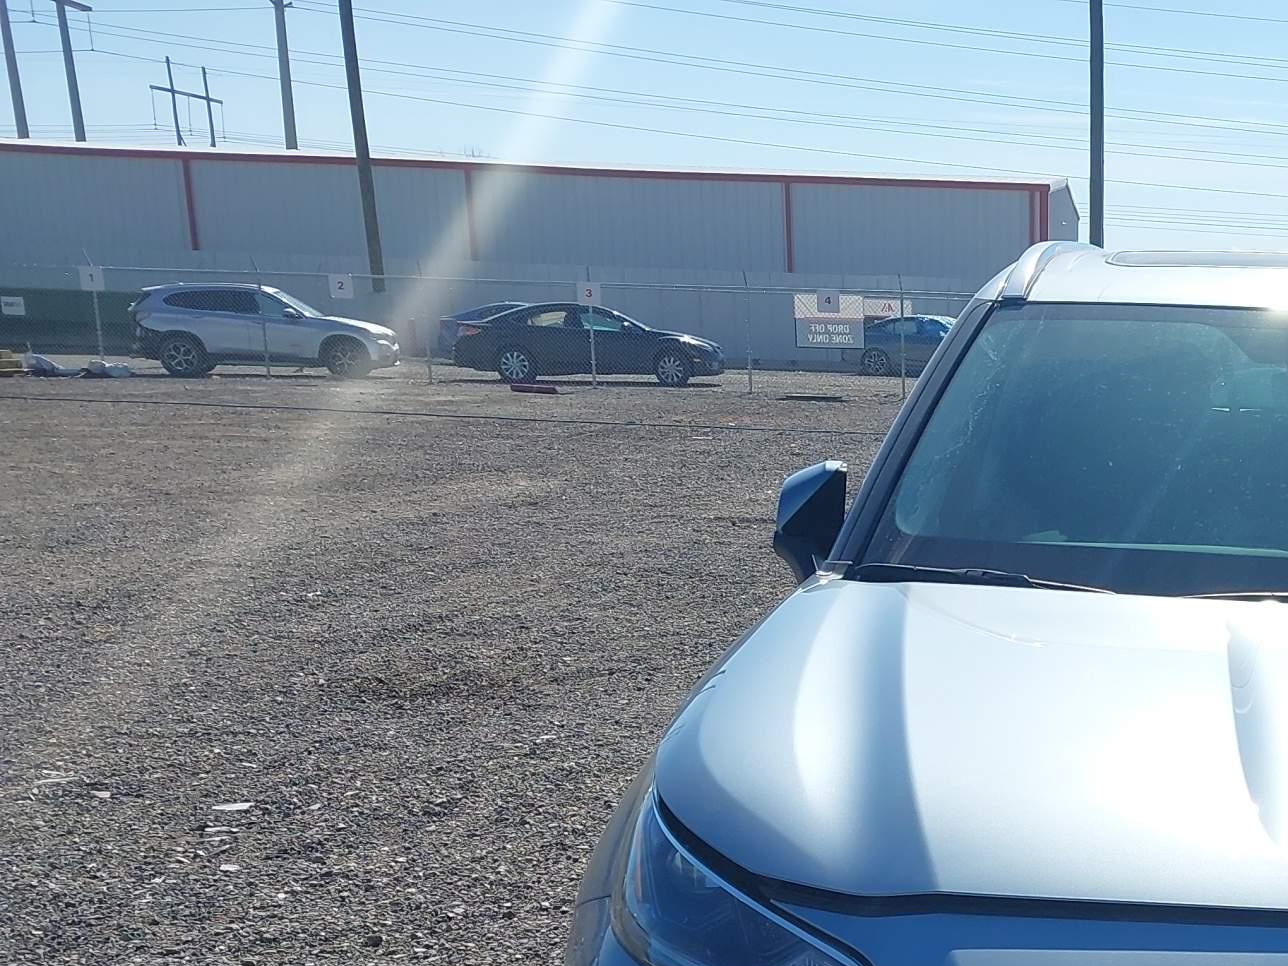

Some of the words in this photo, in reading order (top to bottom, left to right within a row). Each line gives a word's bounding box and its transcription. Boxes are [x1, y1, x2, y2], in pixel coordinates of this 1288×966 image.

[337, 281, 345, 290] 2
[585, 288, 593, 298] 3
[824, 296, 832, 305] 4
